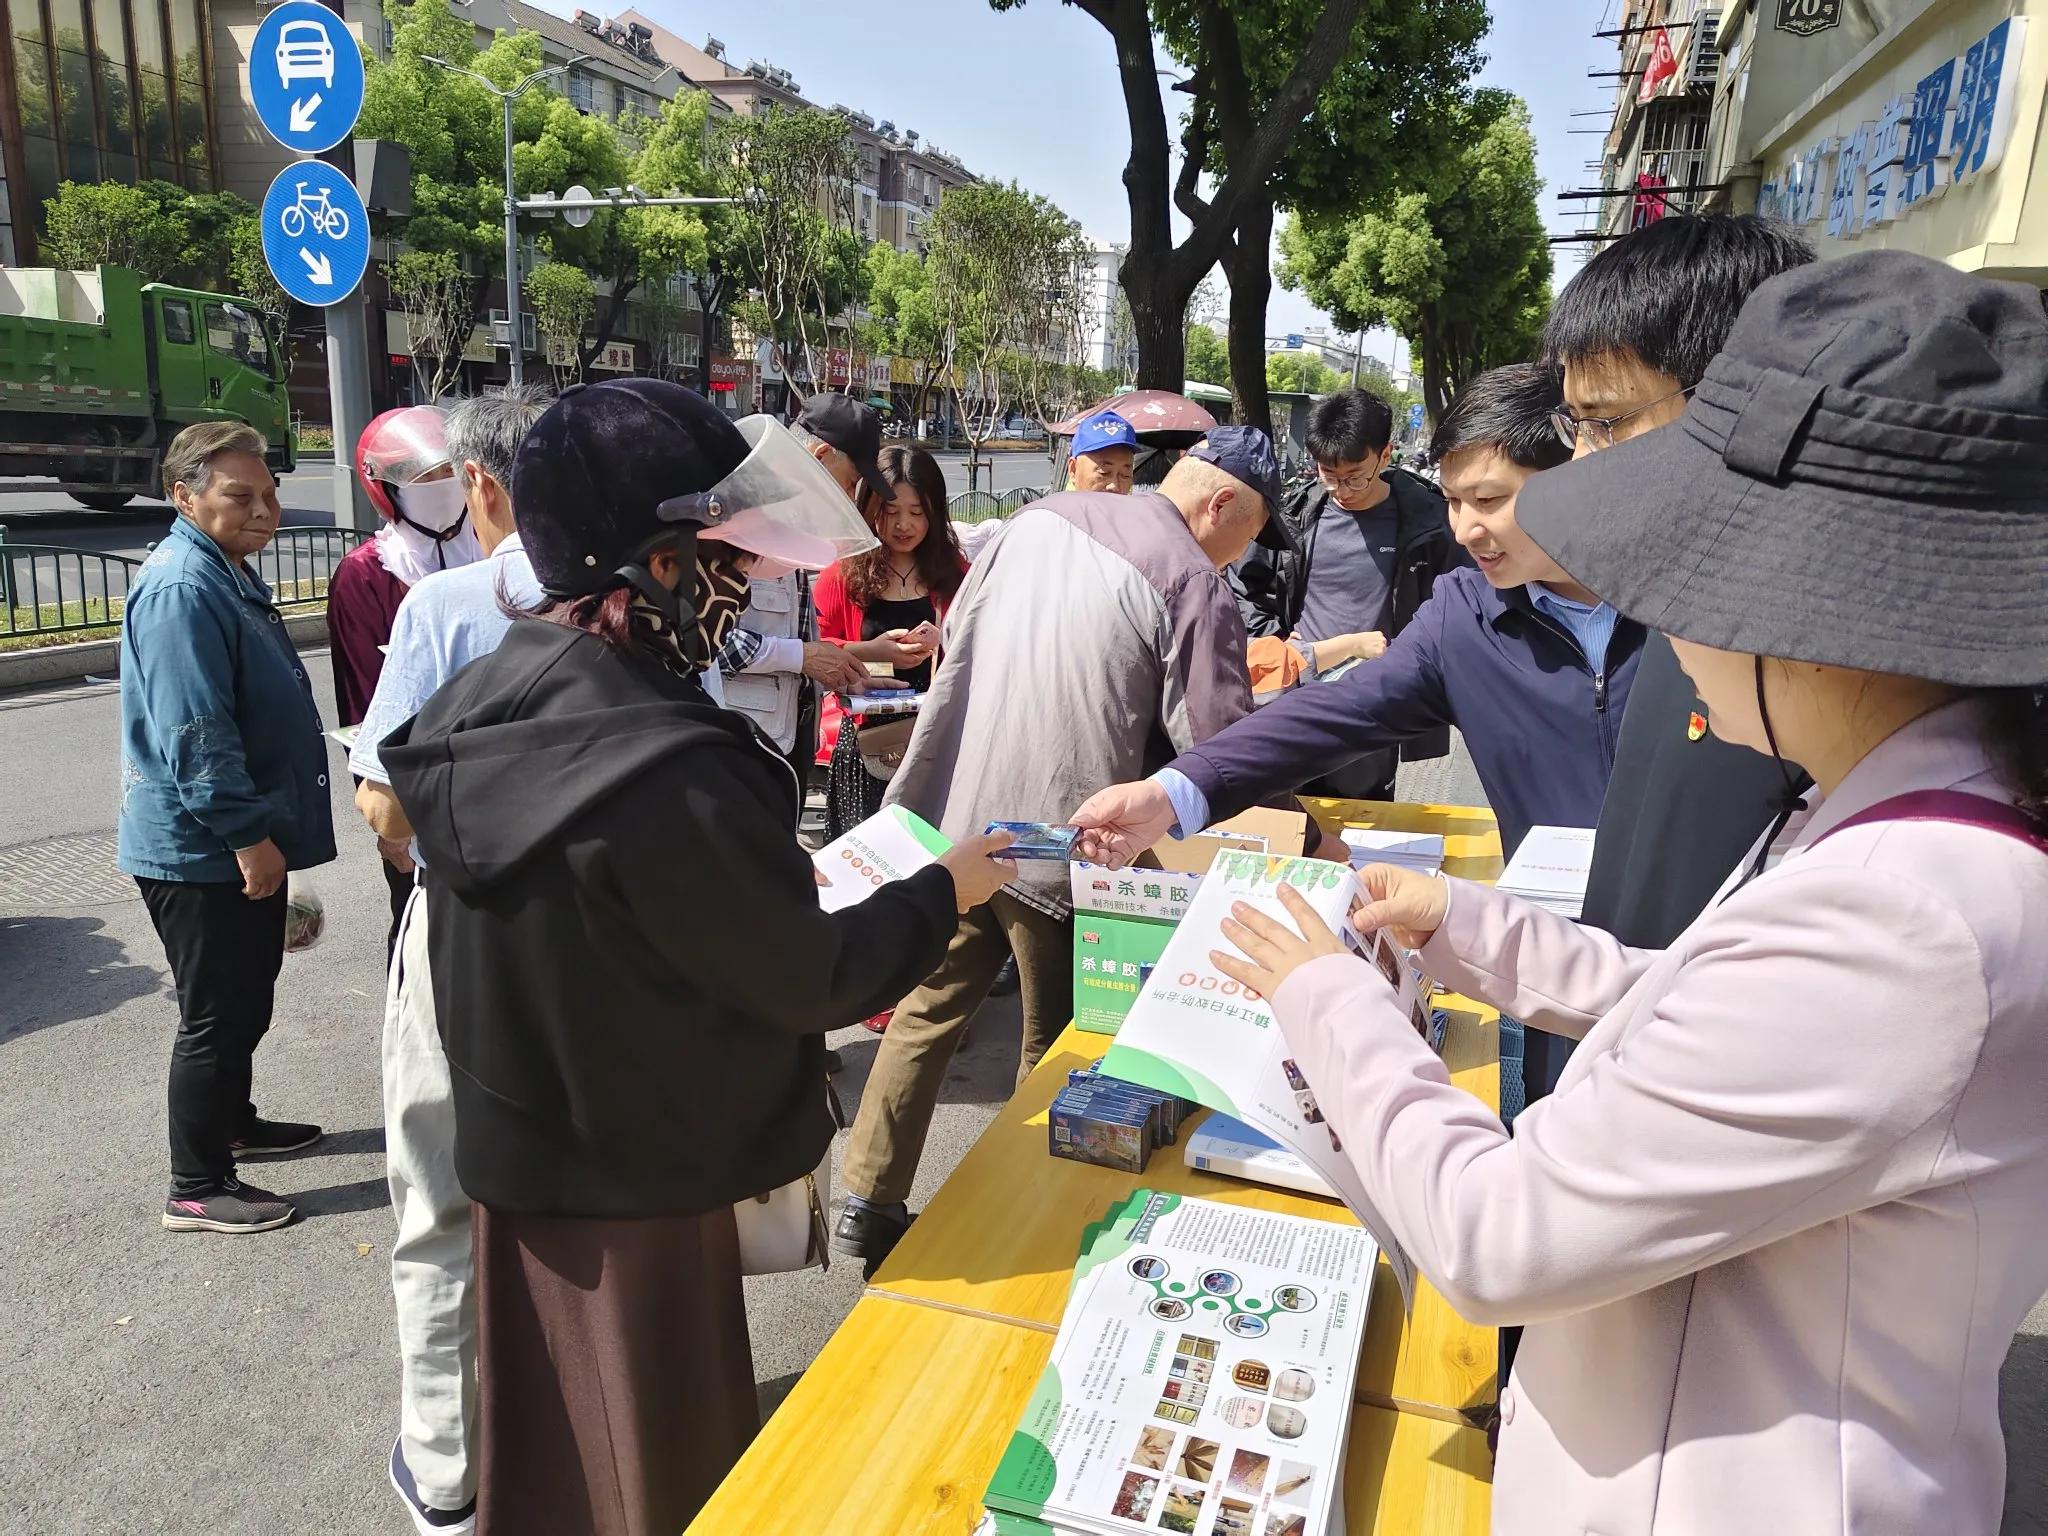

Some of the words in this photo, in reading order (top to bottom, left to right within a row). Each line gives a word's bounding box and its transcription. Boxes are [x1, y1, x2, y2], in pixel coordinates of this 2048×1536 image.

[1117, 880, 1189, 903] 杀蟑胶
[1091, 898, 1148, 913] 制剂新技术
[1081, 956, 1138, 978] 杀蟑胶
[1151, 989, 1271, 1029] 镇江市白蚁防治所
